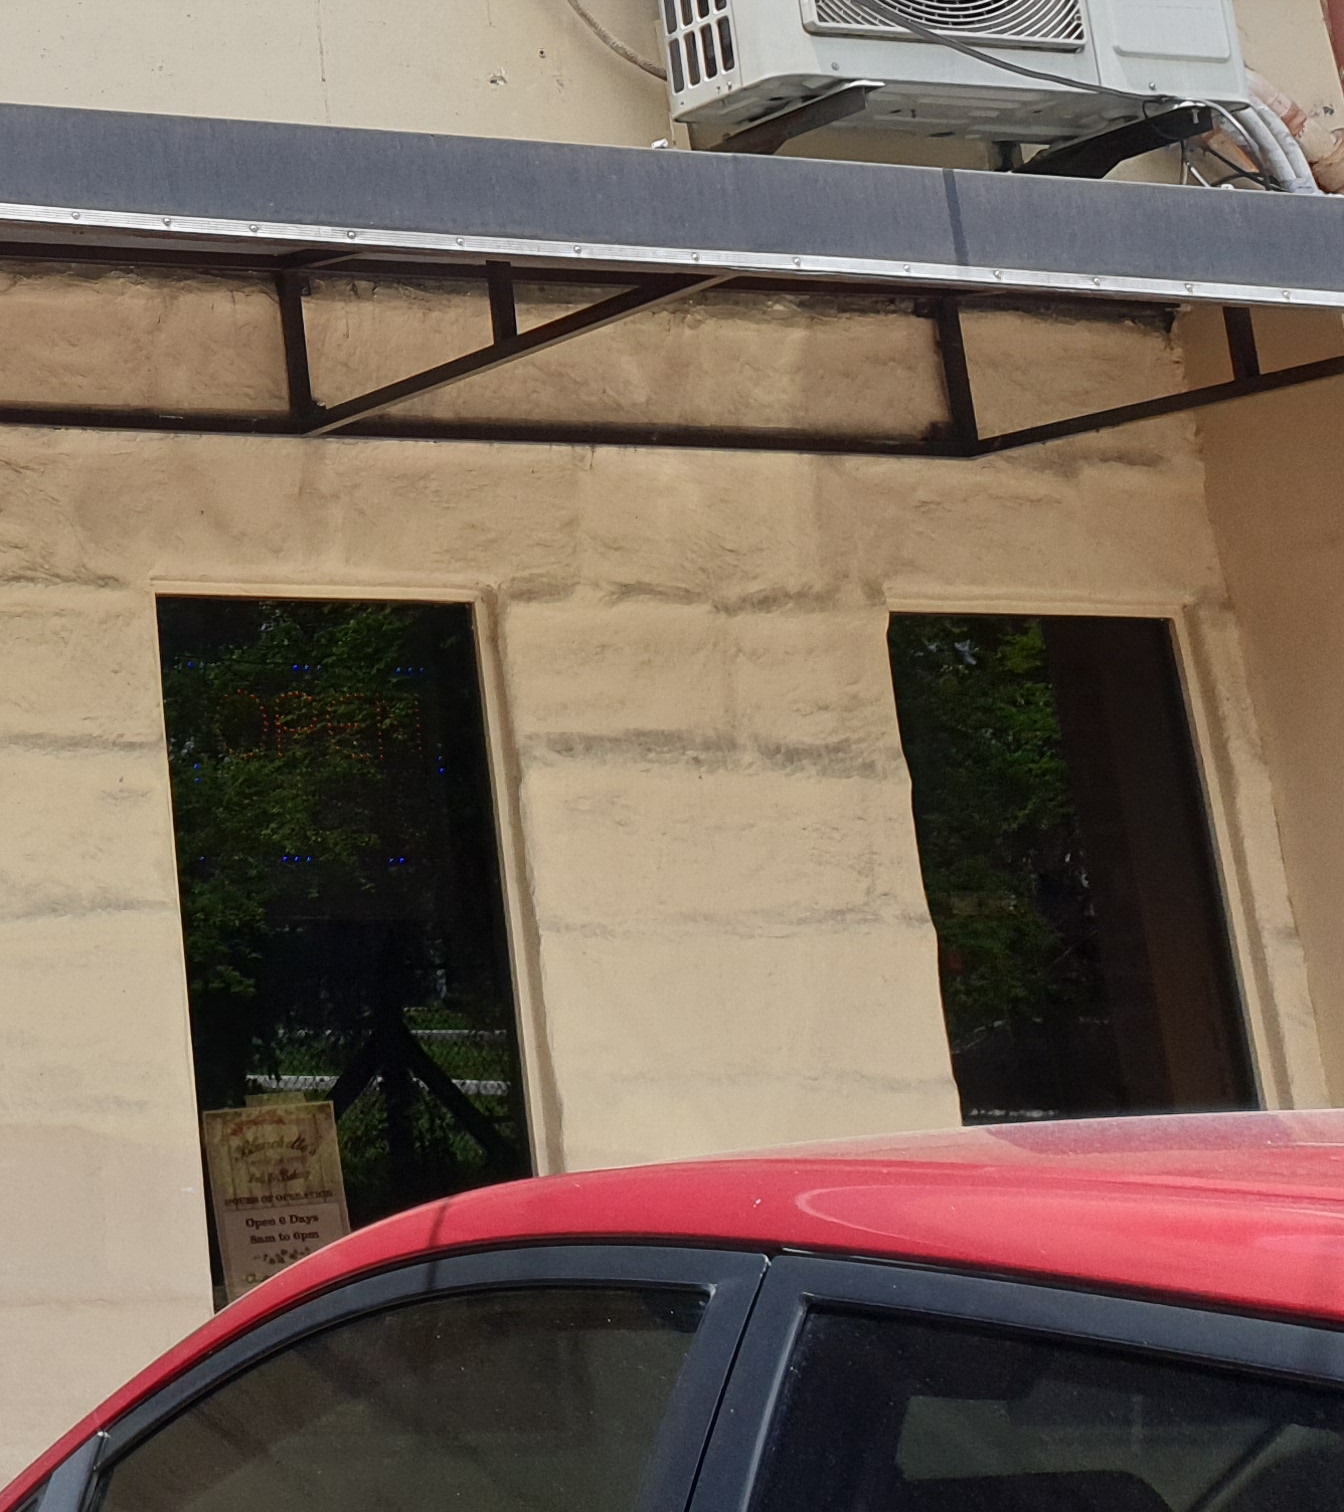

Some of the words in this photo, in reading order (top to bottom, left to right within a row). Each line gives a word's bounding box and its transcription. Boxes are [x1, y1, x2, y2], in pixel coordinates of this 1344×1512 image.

[245, 1217, 276, 1230] Open
[289, 1214, 320, 1225] Days
[278, 1233, 290, 1242] to
